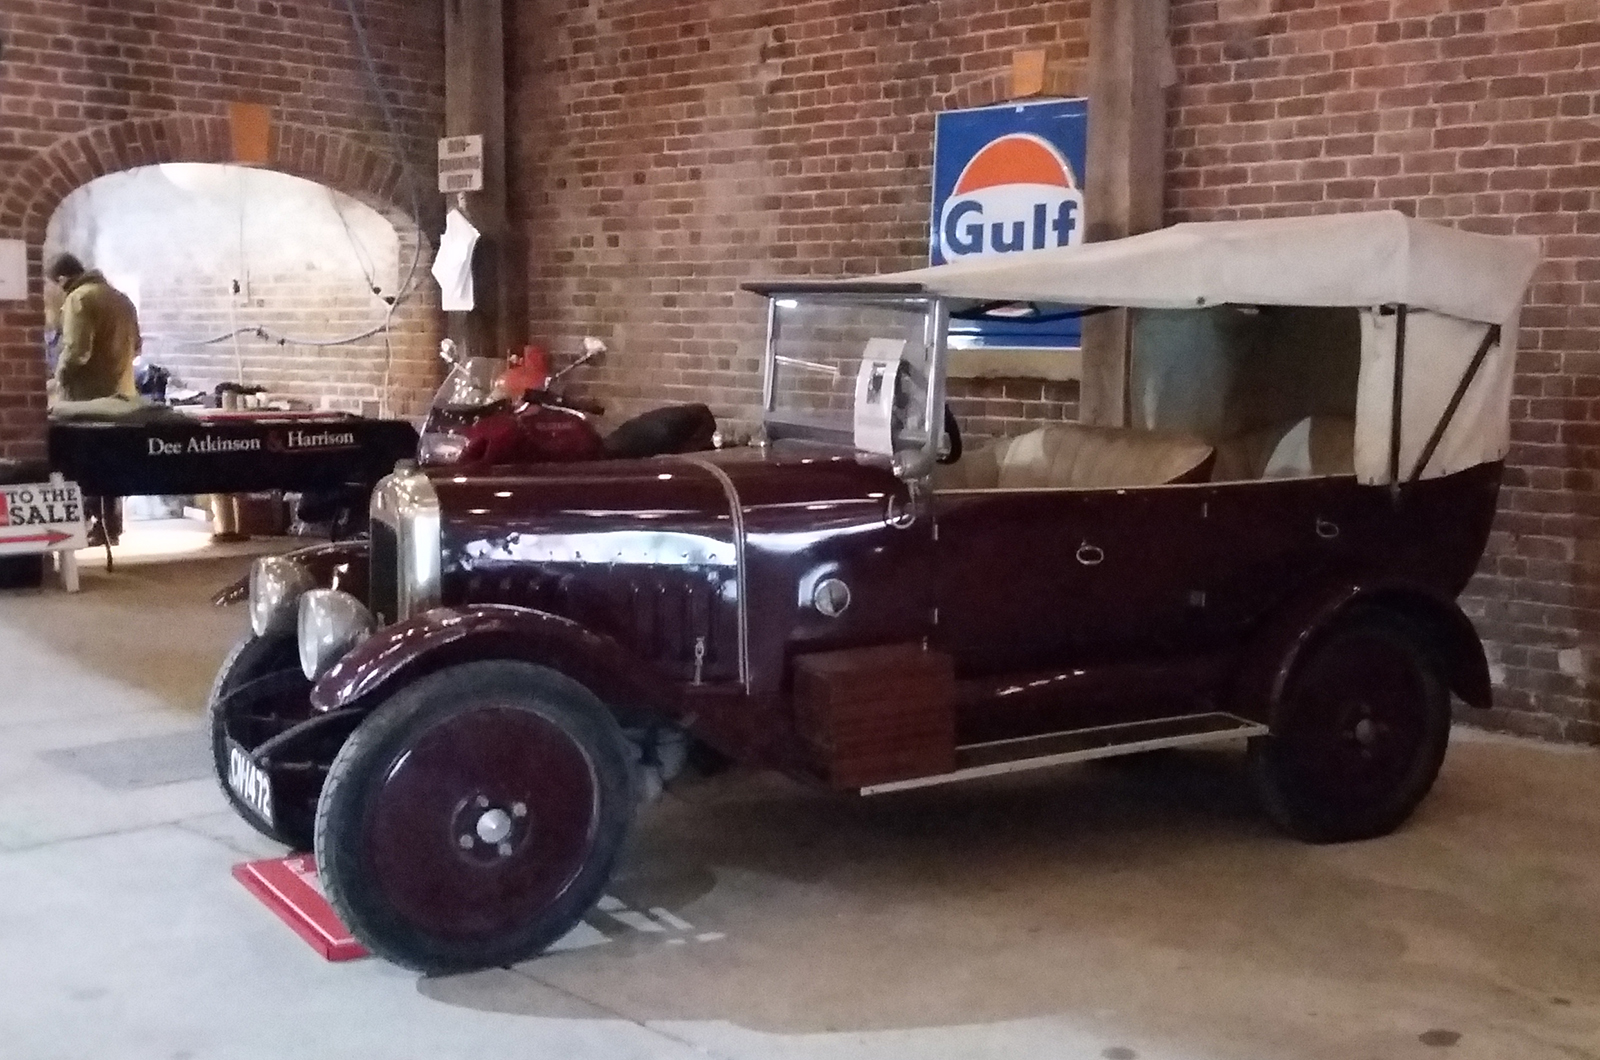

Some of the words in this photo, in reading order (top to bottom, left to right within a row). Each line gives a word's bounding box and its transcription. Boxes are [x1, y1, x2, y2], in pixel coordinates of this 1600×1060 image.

[945, 200, 1077, 256] Gulf
[148, 437, 182, 455] Dee
[187, 434, 261, 453] Atkinson
[287, 430, 354, 448] Harrison
[7, 490, 34, 504] TO
[39, 488, 78, 502] THE
[9, 503, 81, 526] SALE
